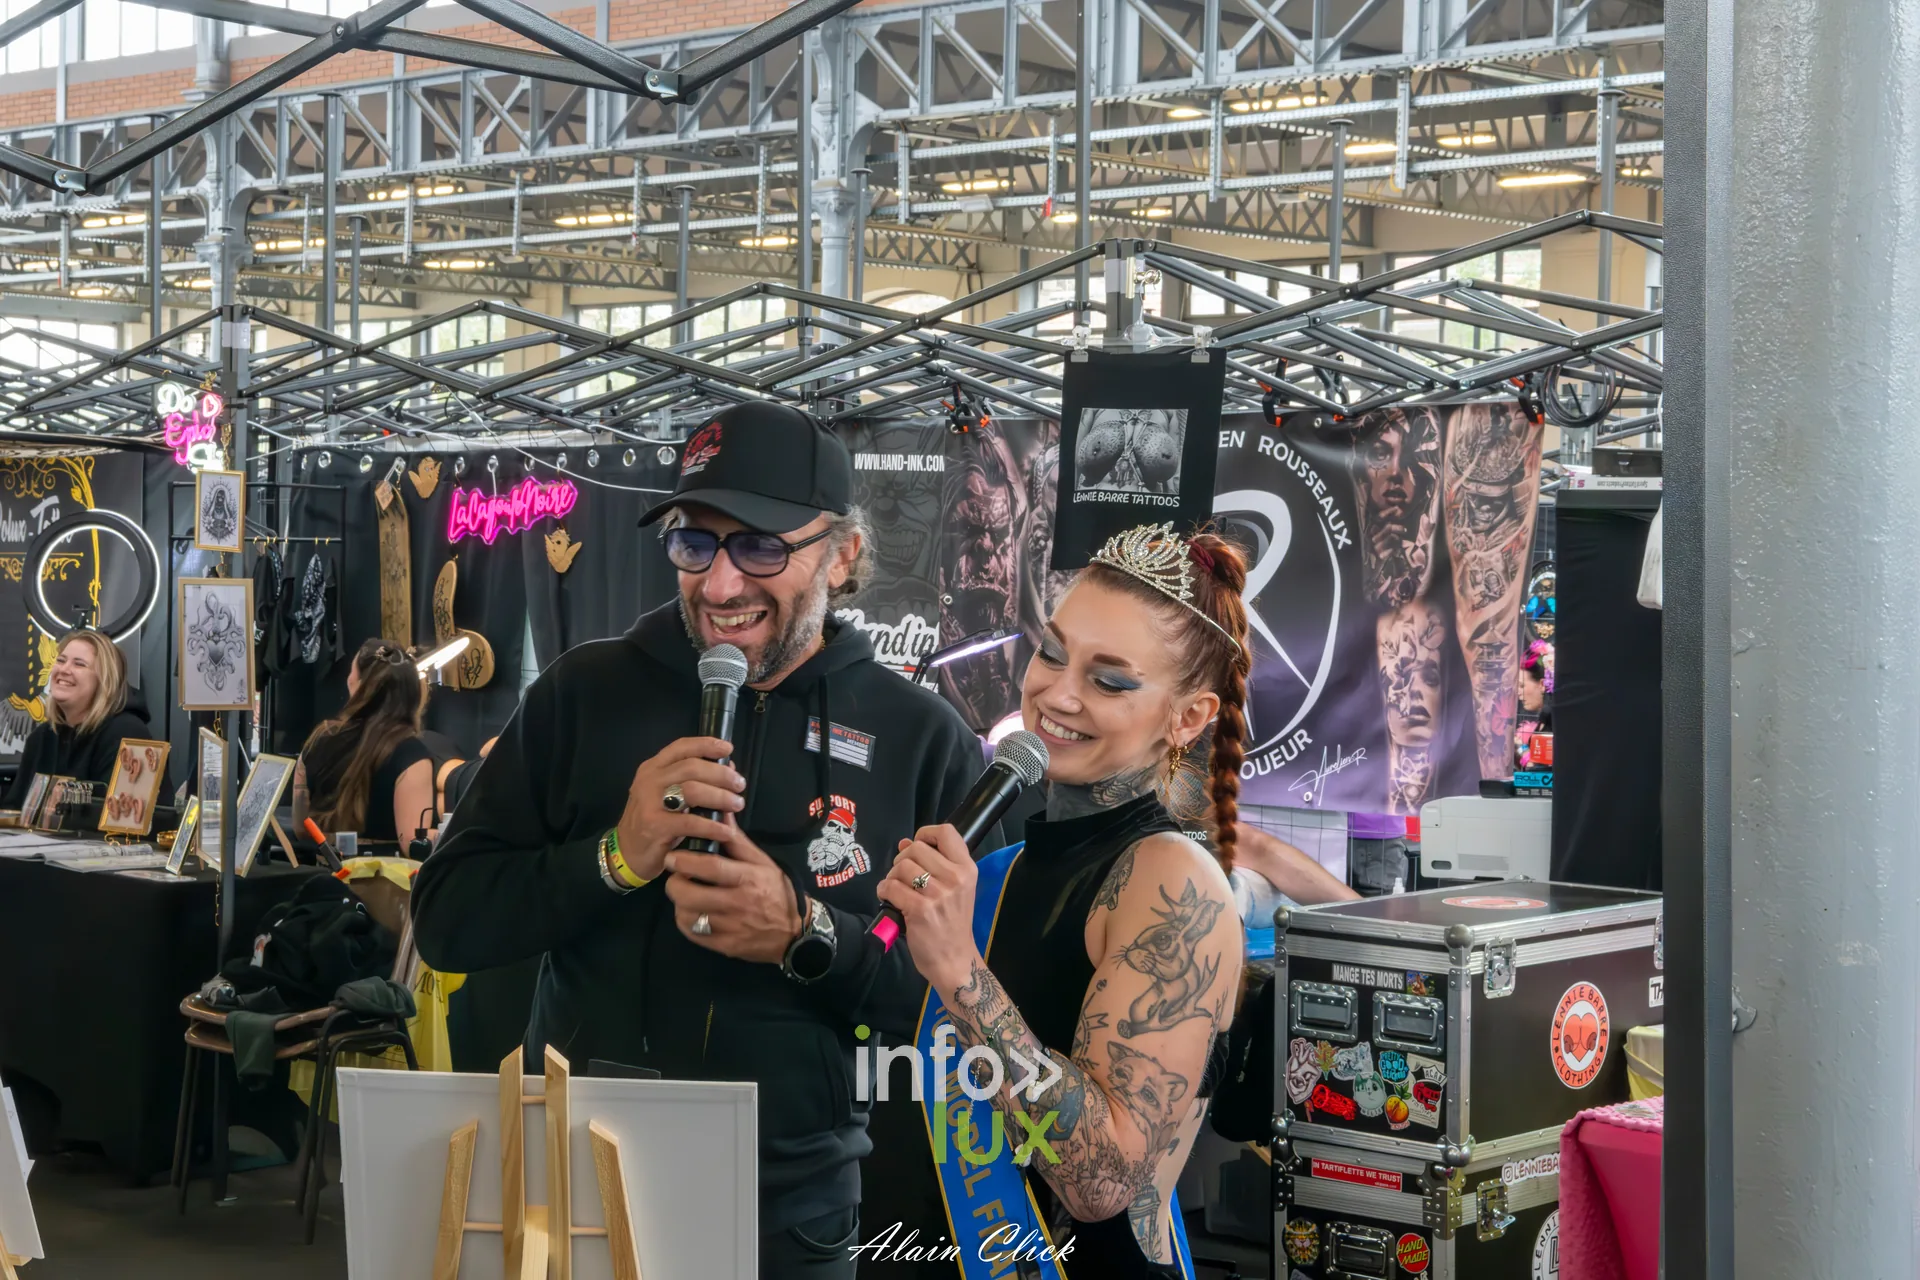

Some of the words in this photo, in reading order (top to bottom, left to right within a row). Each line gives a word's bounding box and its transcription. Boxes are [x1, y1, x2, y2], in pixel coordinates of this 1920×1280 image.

[1072, 491, 1098, 504] LENNIE
[1097, 491, 1130, 504] BARRE
[1131, 494, 1181, 508] TATTOOS
[1257, 435, 1353, 550] ROUSSEAUX
[808, 793, 857, 817] SUPORT
[1182, 830, 1208, 841] TOOS
[815, 865, 856, 889] France
[1332, 964, 1361, 985] MANGE
[1360, 968, 1377, 987] TES
[1376, 970, 1405, 991] MORTS
[1555, 1055, 1601, 1085] CLOTHING
[1321, 1162, 1365, 1177] TARTIFLETTE
[1365, 1170, 1377, 1180] WE
[1378, 1172, 1401, 1183] TRUST
[971, 1198, 1020, 1280] FRA
[1534, 1216, 1557, 1271] LENNI
[1401, 1249, 1429, 1266] MADE
